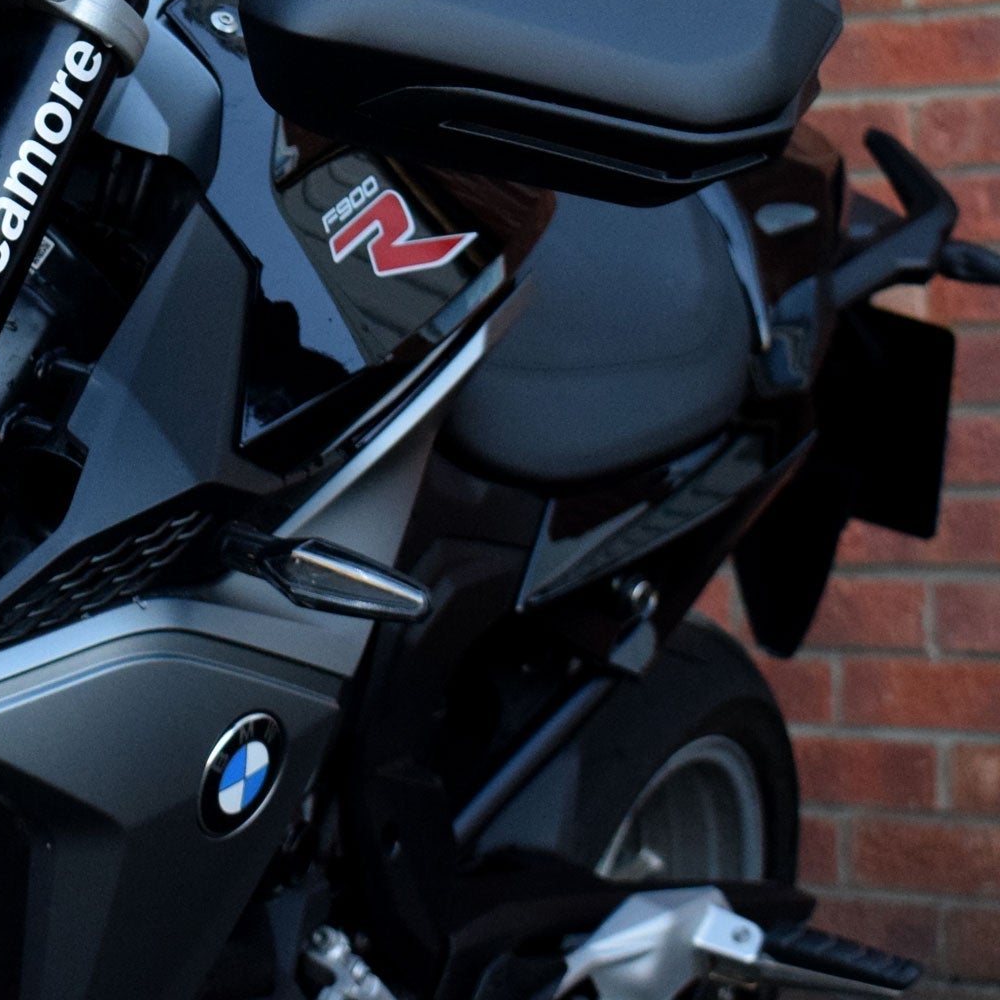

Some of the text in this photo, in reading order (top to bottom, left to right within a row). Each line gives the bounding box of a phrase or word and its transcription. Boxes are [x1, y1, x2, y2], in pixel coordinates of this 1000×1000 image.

[321, 174, 380, 235] F900
[329, 188, 479, 278] R
[210, 718, 281, 775] BMW
